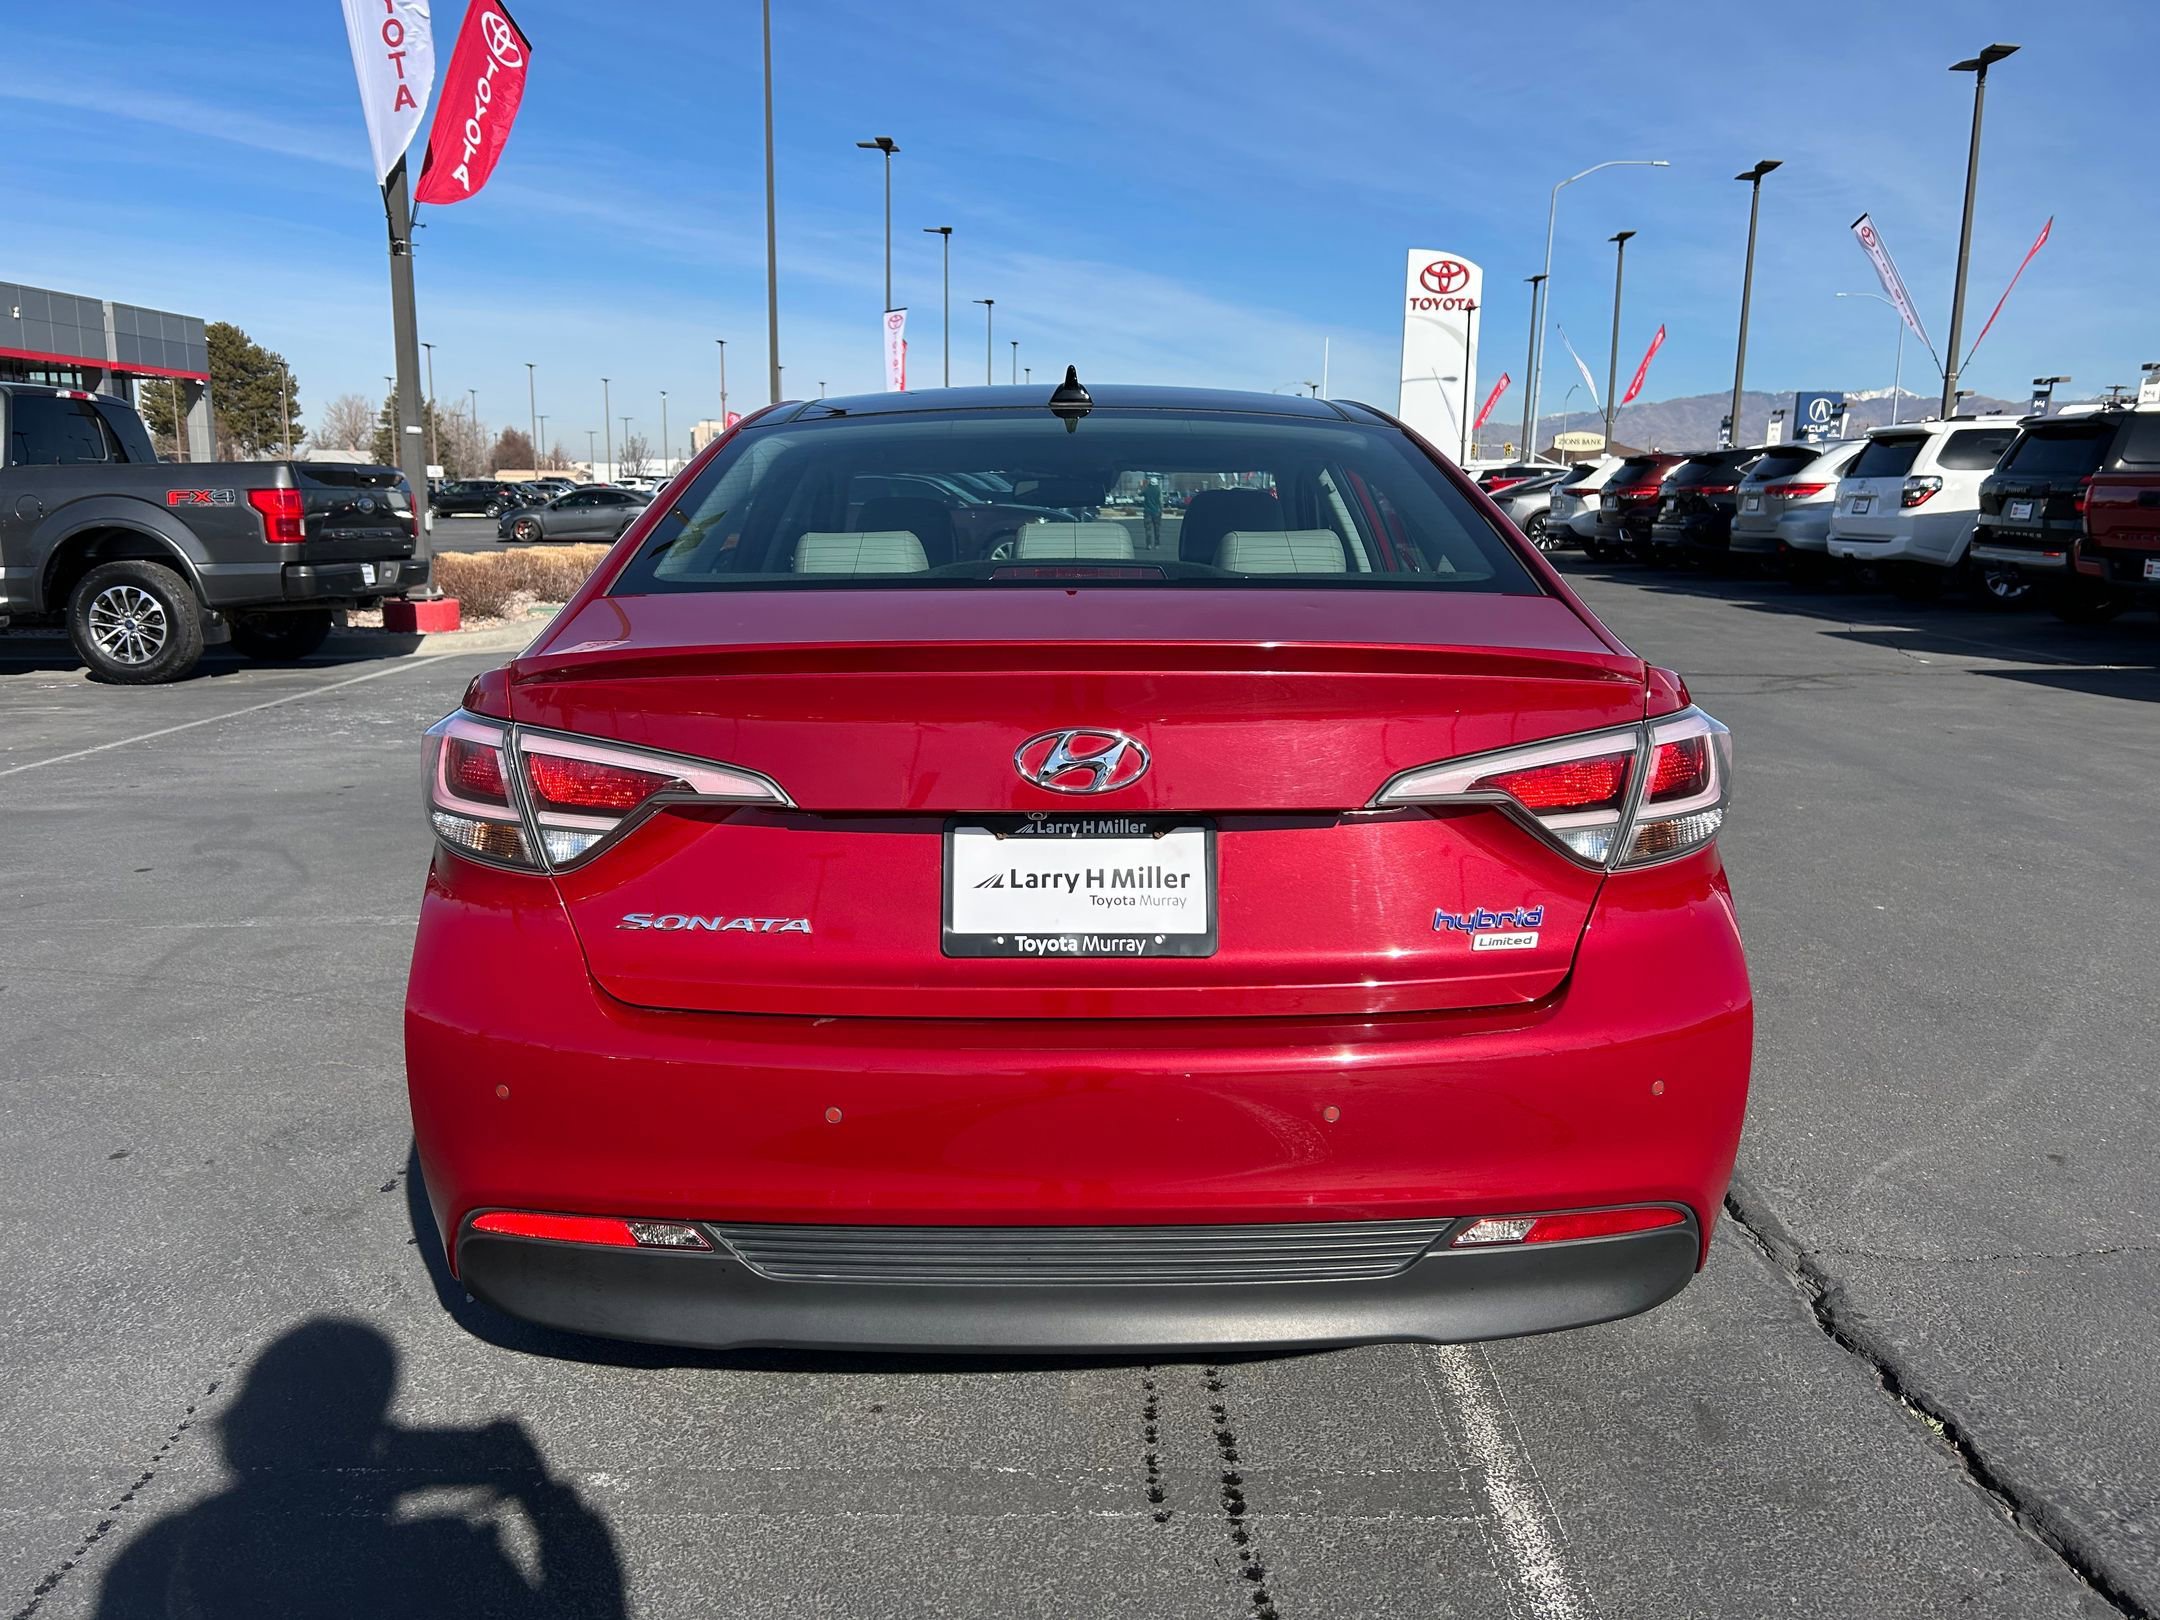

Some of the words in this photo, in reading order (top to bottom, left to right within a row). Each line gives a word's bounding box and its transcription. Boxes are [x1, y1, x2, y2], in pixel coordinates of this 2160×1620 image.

[452, 55, 499, 192] TOYOTA
[1409, 297, 1476, 311] TOYOTA
[167, 489, 235, 507] FX4
[1037, 820, 1080, 835] Larry
[1083, 821, 1095, 833] H
[1098, 819, 1146, 833] Miller
[1010, 868, 1080, 893] Larry
[1086, 868, 1104, 888] H
[1111, 866, 1190, 888] Miller
[1090, 895, 1136, 909] Toyota
[1139, 895, 1187, 909] Murray
[615, 913, 813, 934] SONATA
[1433, 905, 1544, 934] hybrid
[1015, 936, 1077, 955] Toyota
[1083, 936, 1146, 955] Murray
[1478, 936, 1533, 947] Limited
